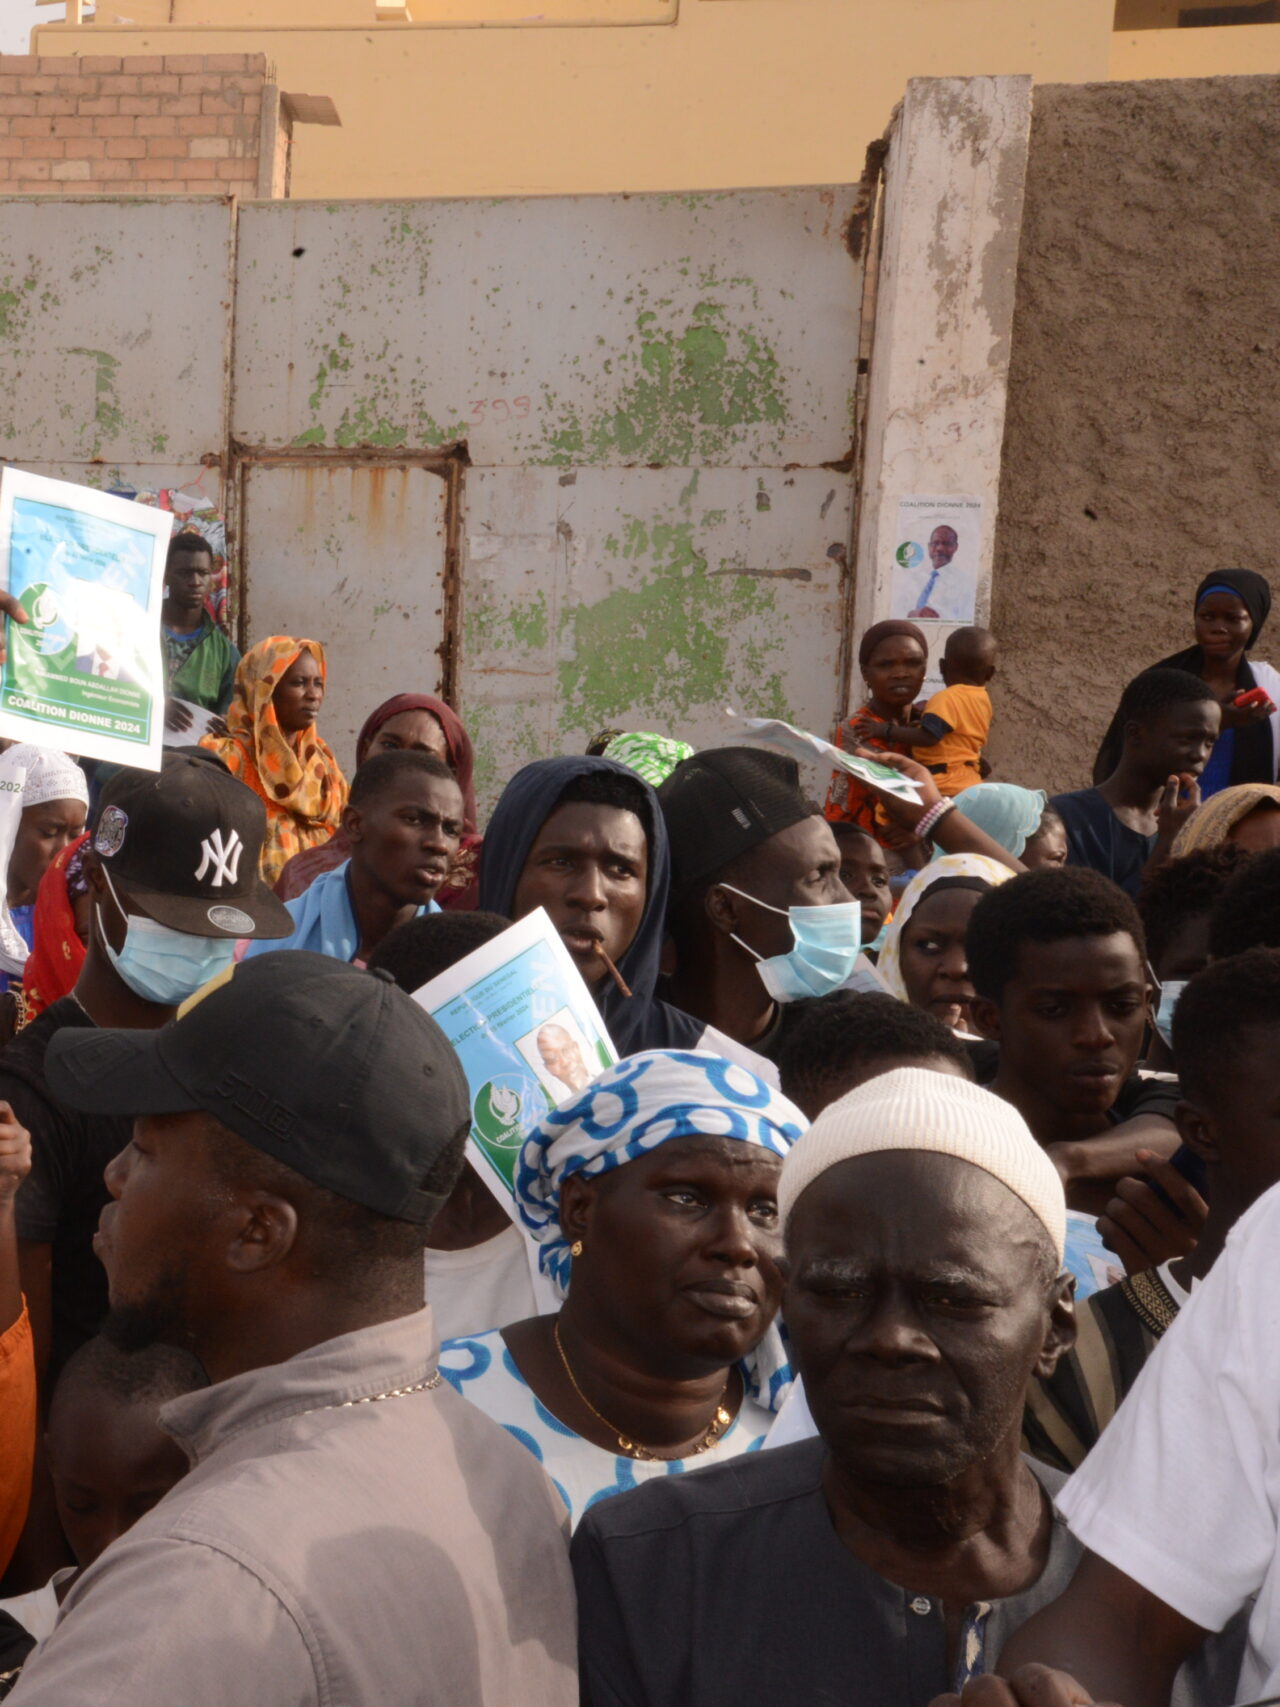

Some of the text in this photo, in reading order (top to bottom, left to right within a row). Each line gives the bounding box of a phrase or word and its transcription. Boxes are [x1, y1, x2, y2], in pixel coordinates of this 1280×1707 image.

[7, 695, 141, 734] COALITION DIONNE 2024
